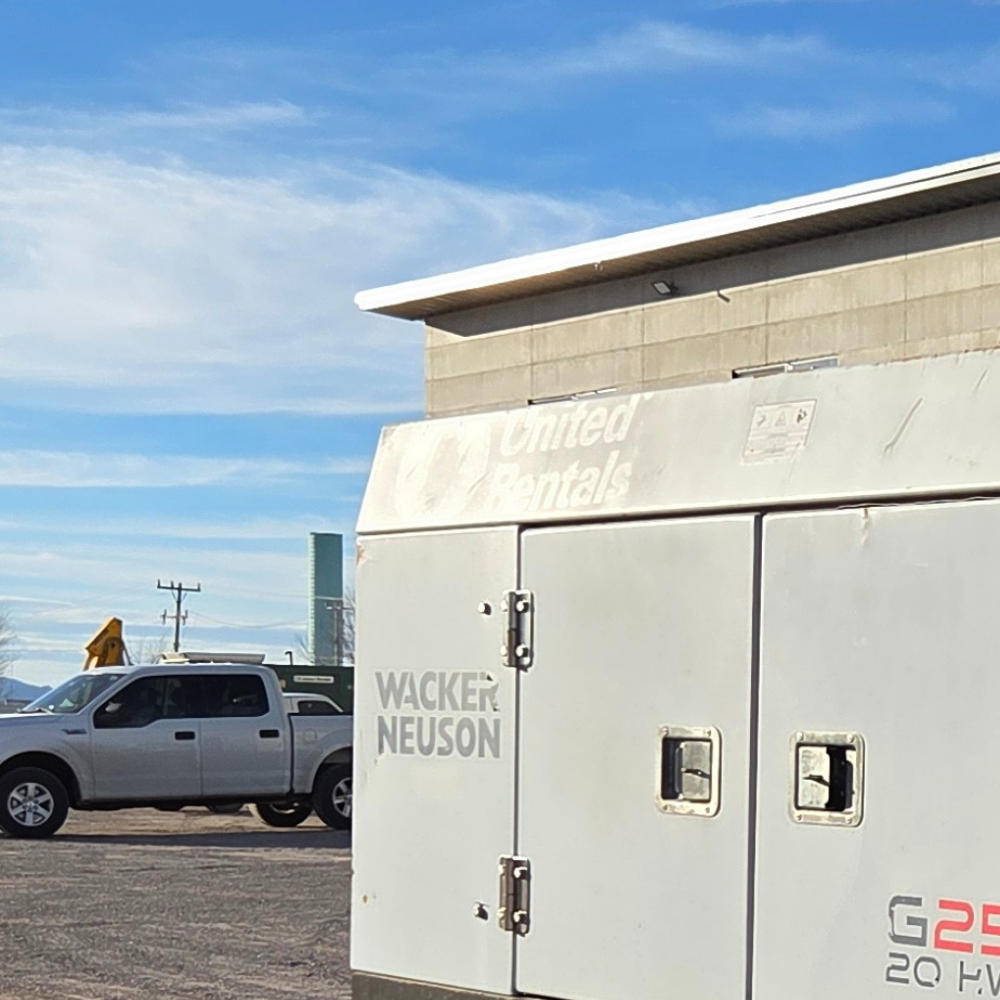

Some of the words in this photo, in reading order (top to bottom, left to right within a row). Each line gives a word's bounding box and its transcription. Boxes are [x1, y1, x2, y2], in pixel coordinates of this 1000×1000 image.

[501, 393, 641, 457] United
[485, 450, 632, 512] Rentals
[374, 671, 499, 712] WACKER
[377, 715, 501, 759] NEUSON
[885, 952, 941, 988] 20
